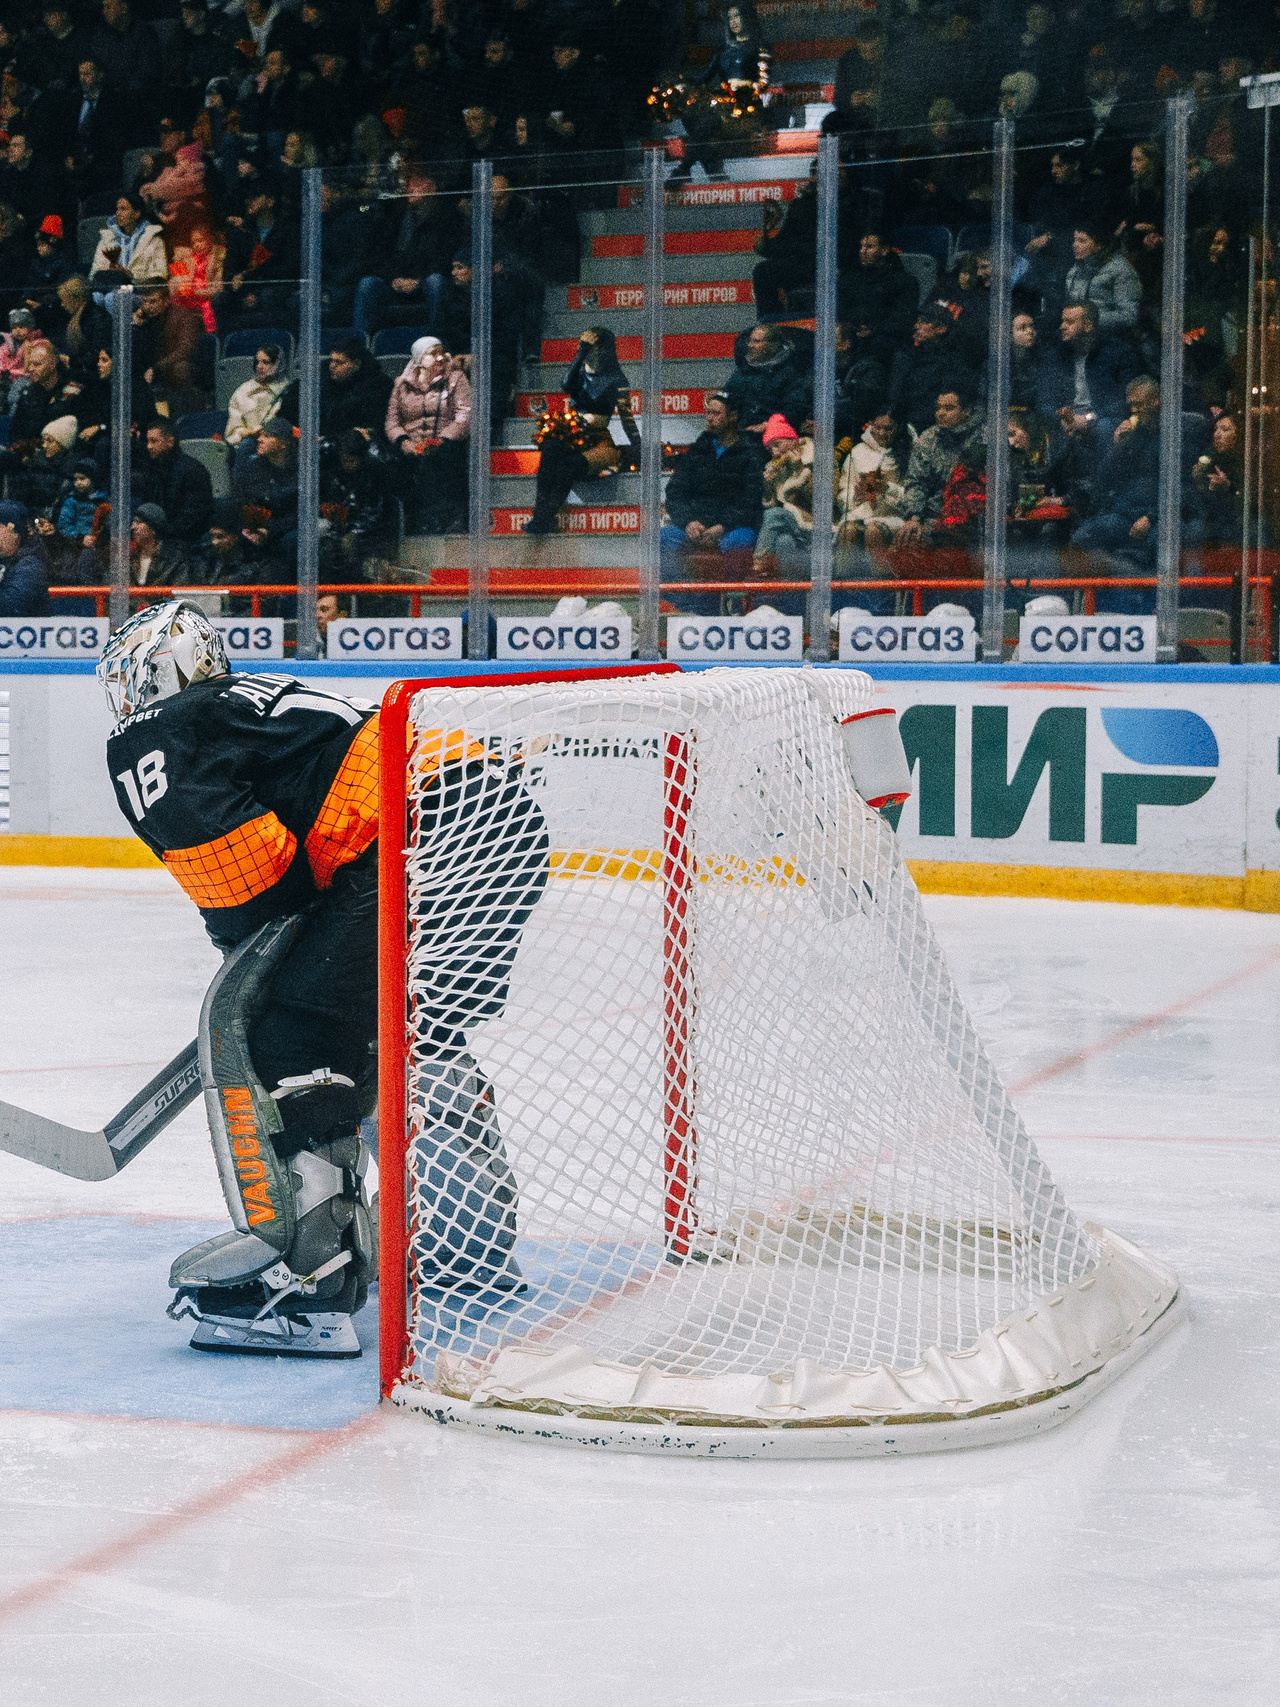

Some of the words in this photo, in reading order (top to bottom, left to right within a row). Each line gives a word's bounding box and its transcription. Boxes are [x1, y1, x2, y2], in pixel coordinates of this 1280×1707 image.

[738, 186, 782, 201] ТИГРОВ
[615, 288, 688, 305] ТЕРРРИЯ
[691, 286, 737, 303] ТИГРОВ
[590, 511, 638, 529] ТИГРОВ
[117, 750, 168, 822] 18
[222, 1087, 276, 1227] VAUGHN
